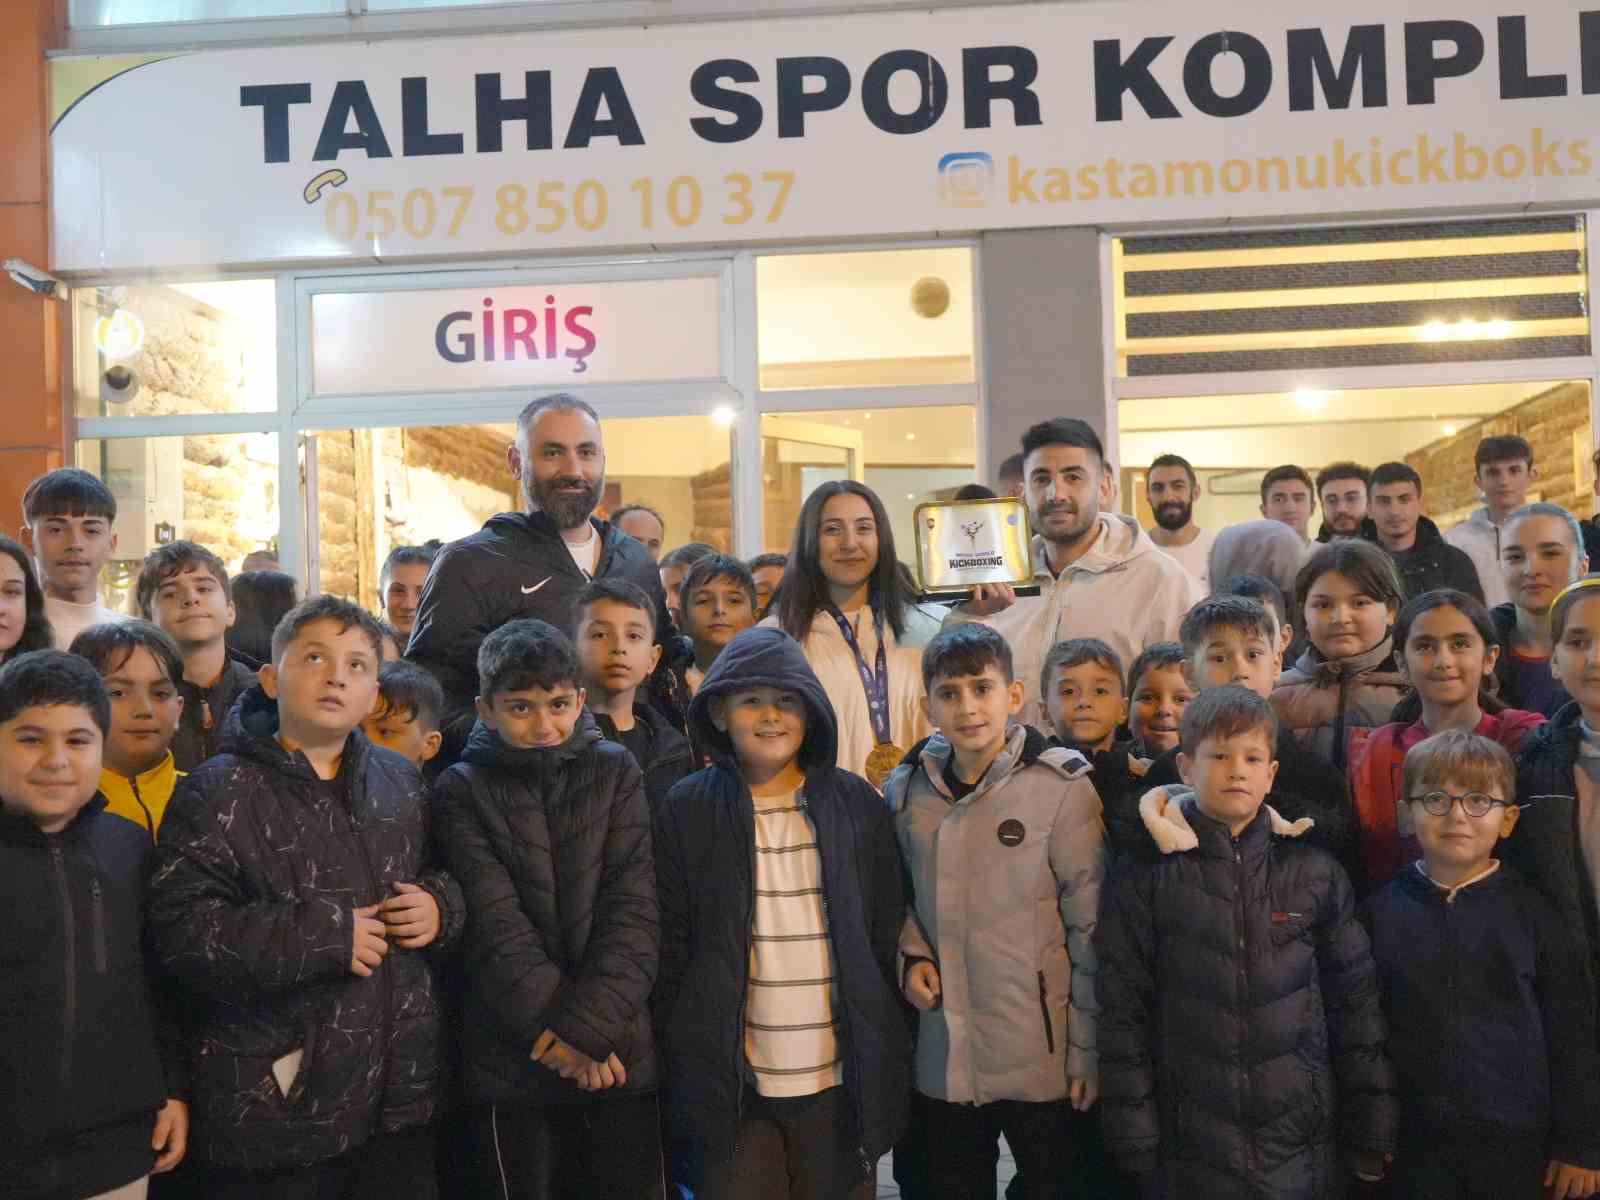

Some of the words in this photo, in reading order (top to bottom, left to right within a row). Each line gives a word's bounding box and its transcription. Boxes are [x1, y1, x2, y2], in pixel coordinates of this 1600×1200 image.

[240, 66, 646, 164] TALHA
[689, 47, 1044, 143] SPOR
[1008, 128, 1593, 204] kastamonukickboks
[325, 185, 476, 242] 0507
[495, 180, 608, 236] 850
[632, 176, 704, 230] 10
[722, 171, 797, 226] 37
[434, 294, 598, 374] GİRİŞ
[949, 556, 1003, 569] KICKBOXING
